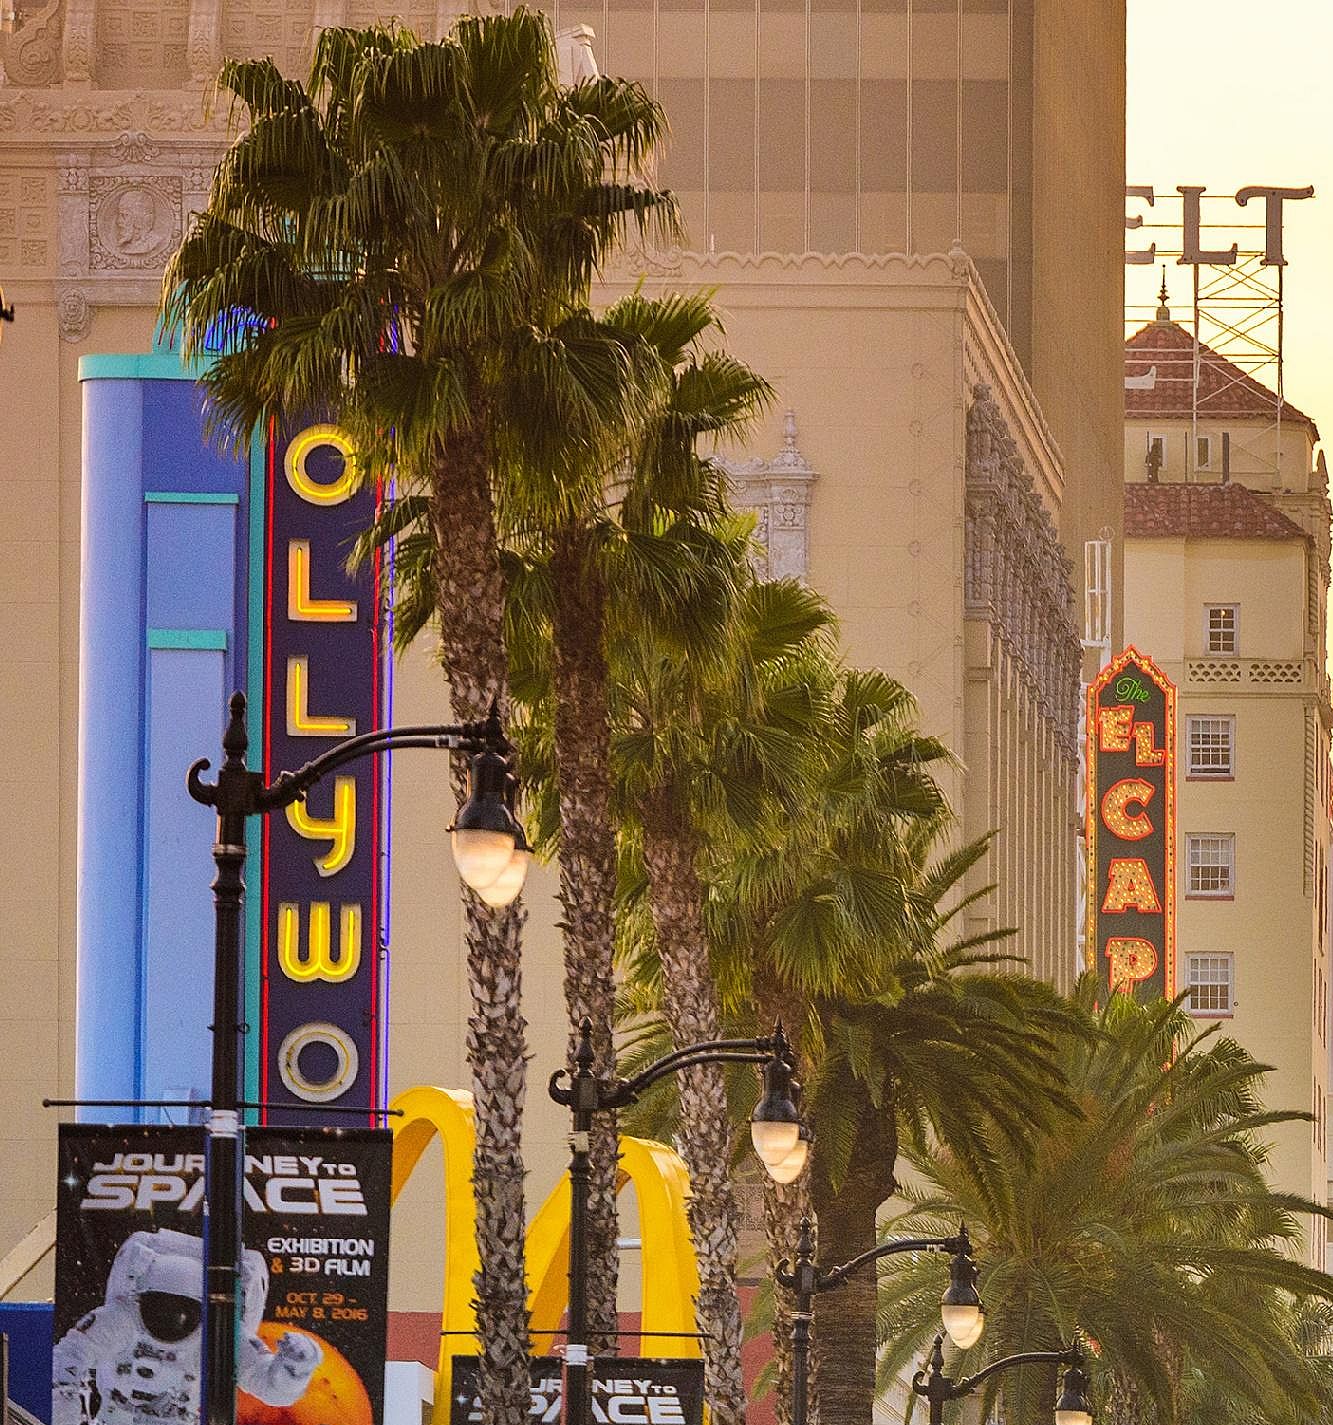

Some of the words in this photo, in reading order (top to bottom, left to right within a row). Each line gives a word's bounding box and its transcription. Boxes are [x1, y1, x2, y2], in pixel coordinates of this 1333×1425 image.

[1125, 185, 1314, 266] ELT
[1115, 677, 1150, 703] The
[1099, 705, 1166, 766] EL
[1101, 778, 1162, 995] CAP
[323, 1163, 356, 1176] TO
[268, 1238, 374, 1255] EXHIBITION
[289, 1258, 321, 1273] 3D
[325, 1259, 370, 1277] FILM
